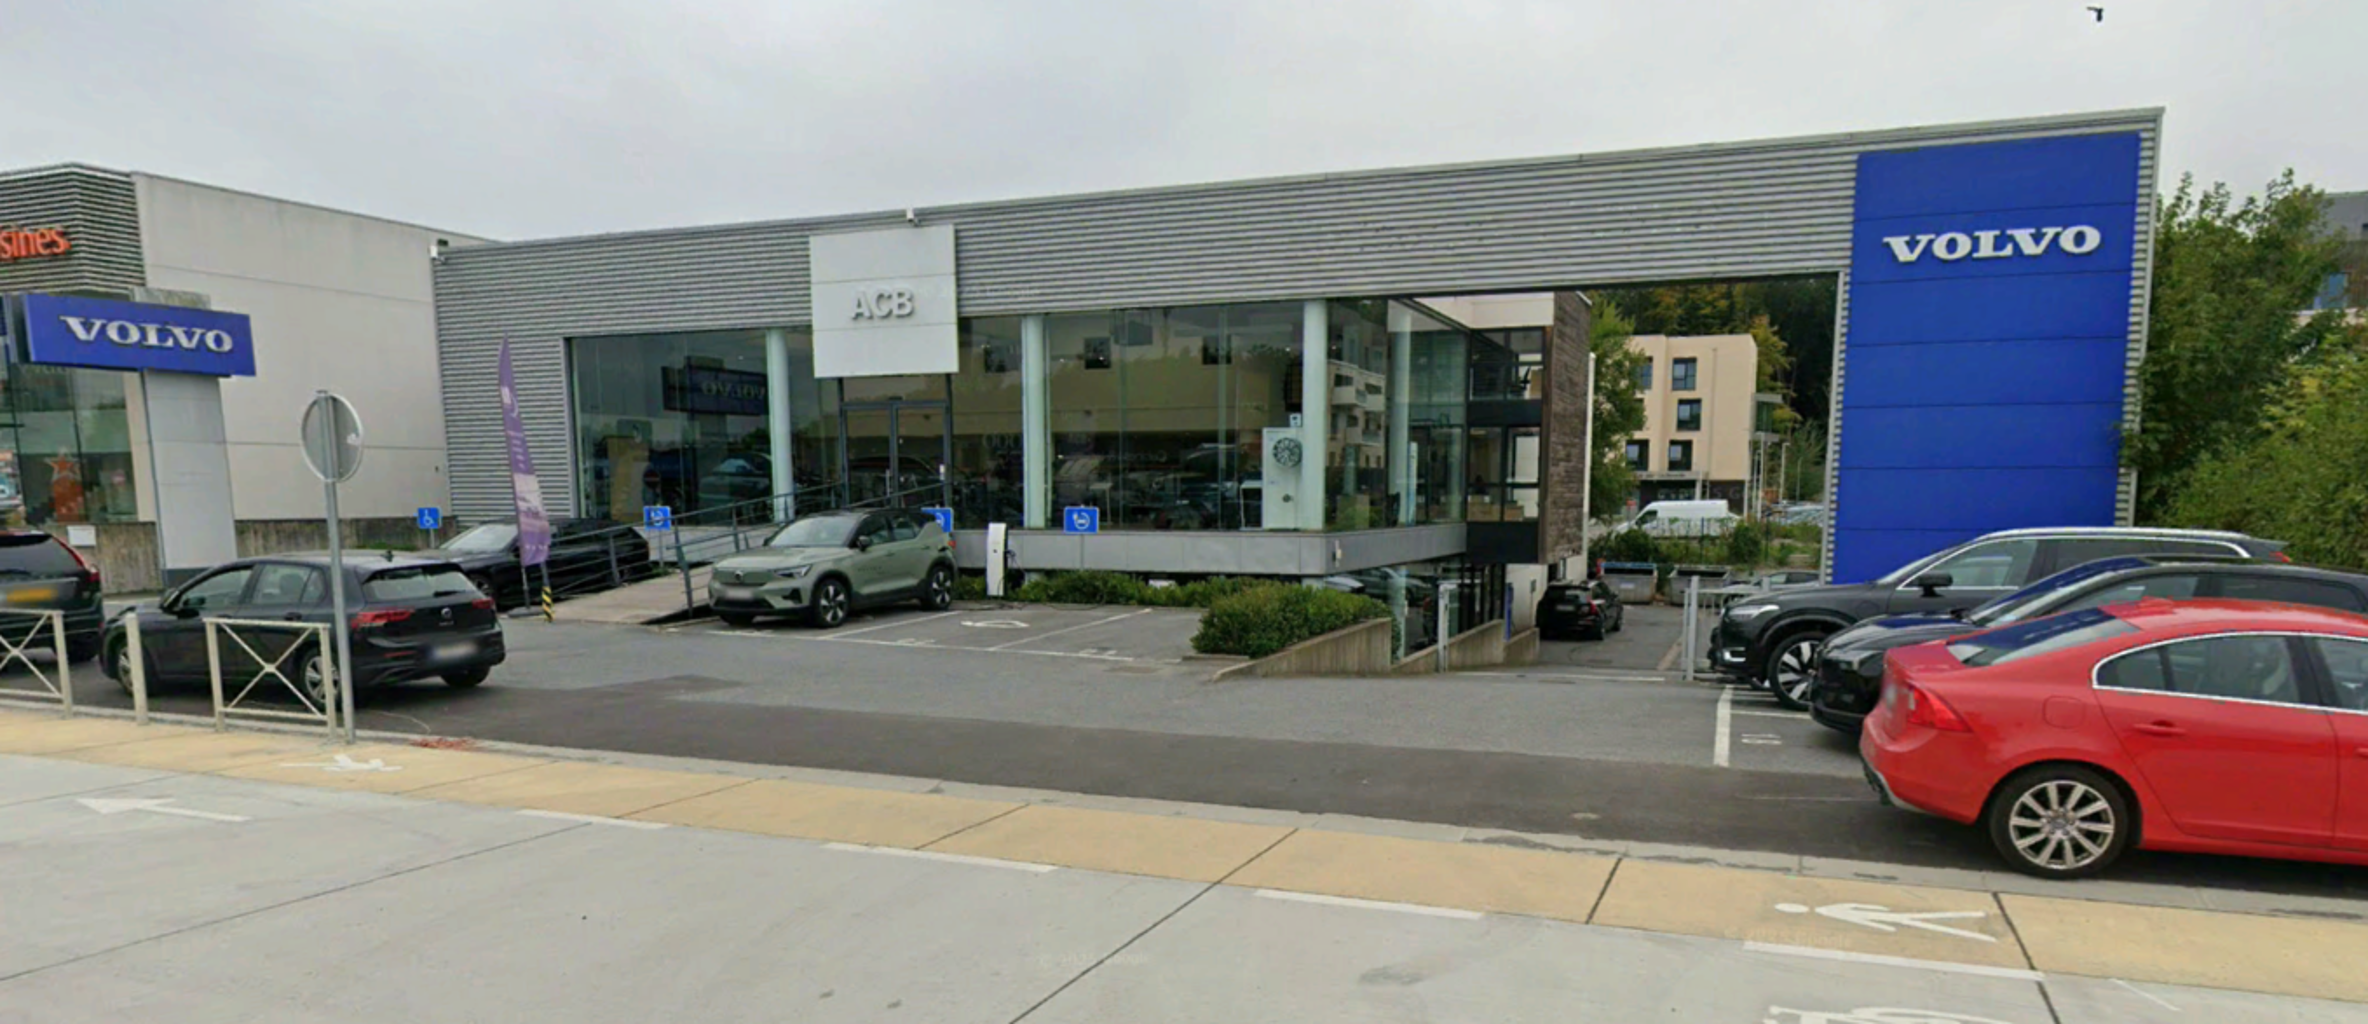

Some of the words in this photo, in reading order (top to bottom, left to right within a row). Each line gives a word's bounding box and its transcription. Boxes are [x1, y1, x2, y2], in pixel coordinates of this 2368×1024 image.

[1882, 224, 2101, 263] VOLVO
[851, 287, 914, 320] ACB
[60, 315, 233, 353] VOLVO
